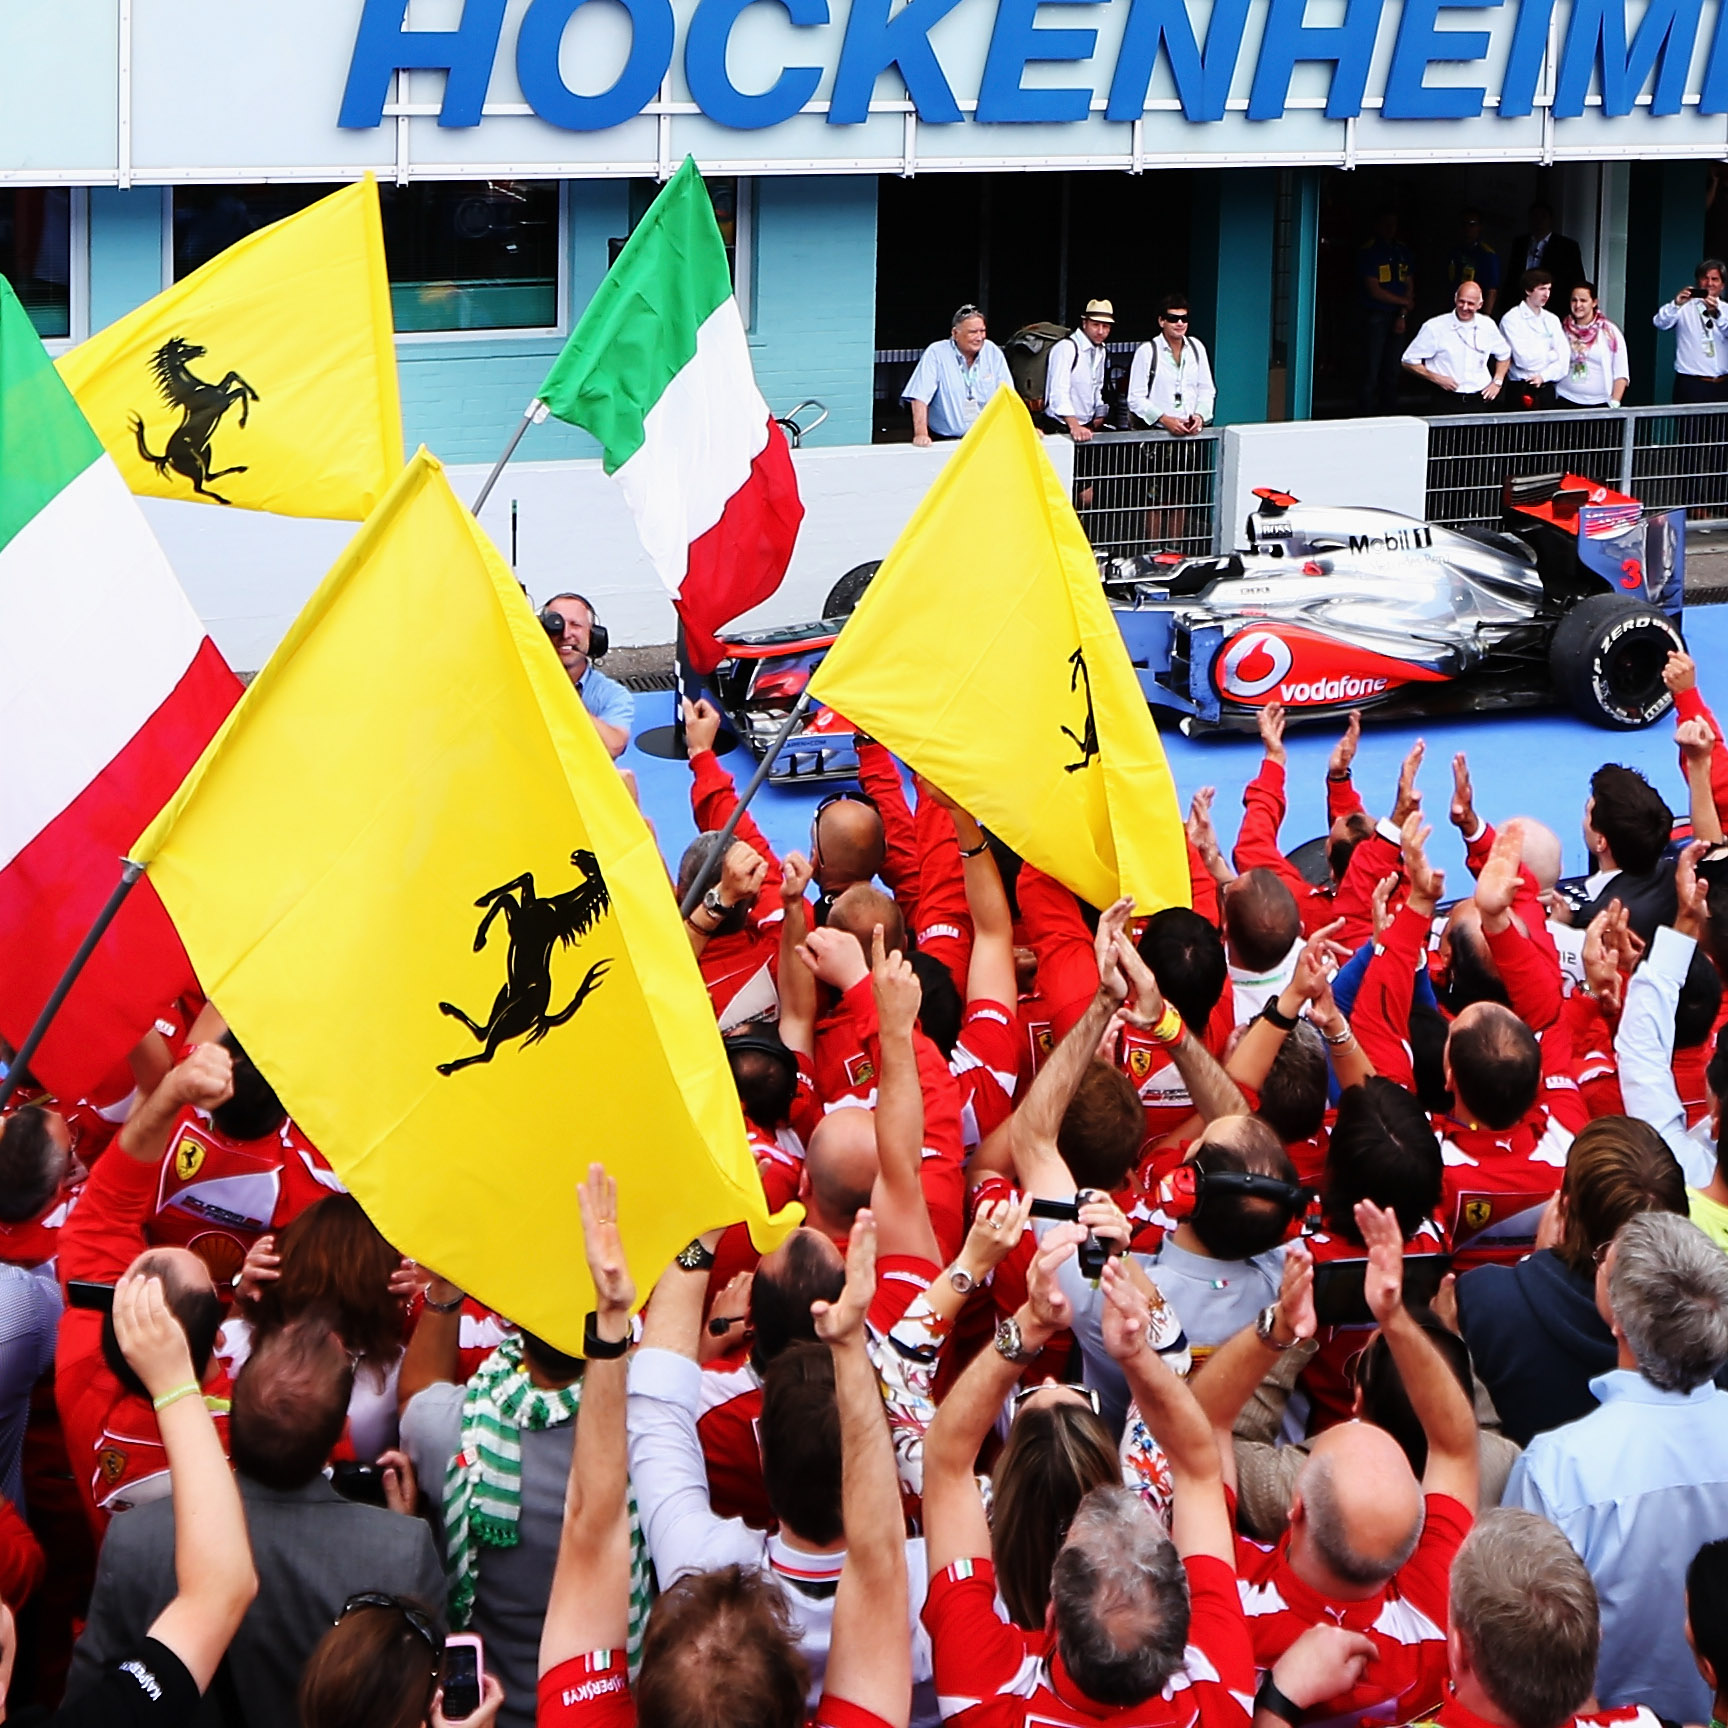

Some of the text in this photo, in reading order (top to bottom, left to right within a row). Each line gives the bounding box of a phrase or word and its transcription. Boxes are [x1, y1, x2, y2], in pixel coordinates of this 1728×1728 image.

[1348, 529, 1412, 556] Mobil
[1619, 557, 1644, 590] 3
[1600, 616, 1651, 655] ZERO
[1280, 675, 1388, 703] vodafone
